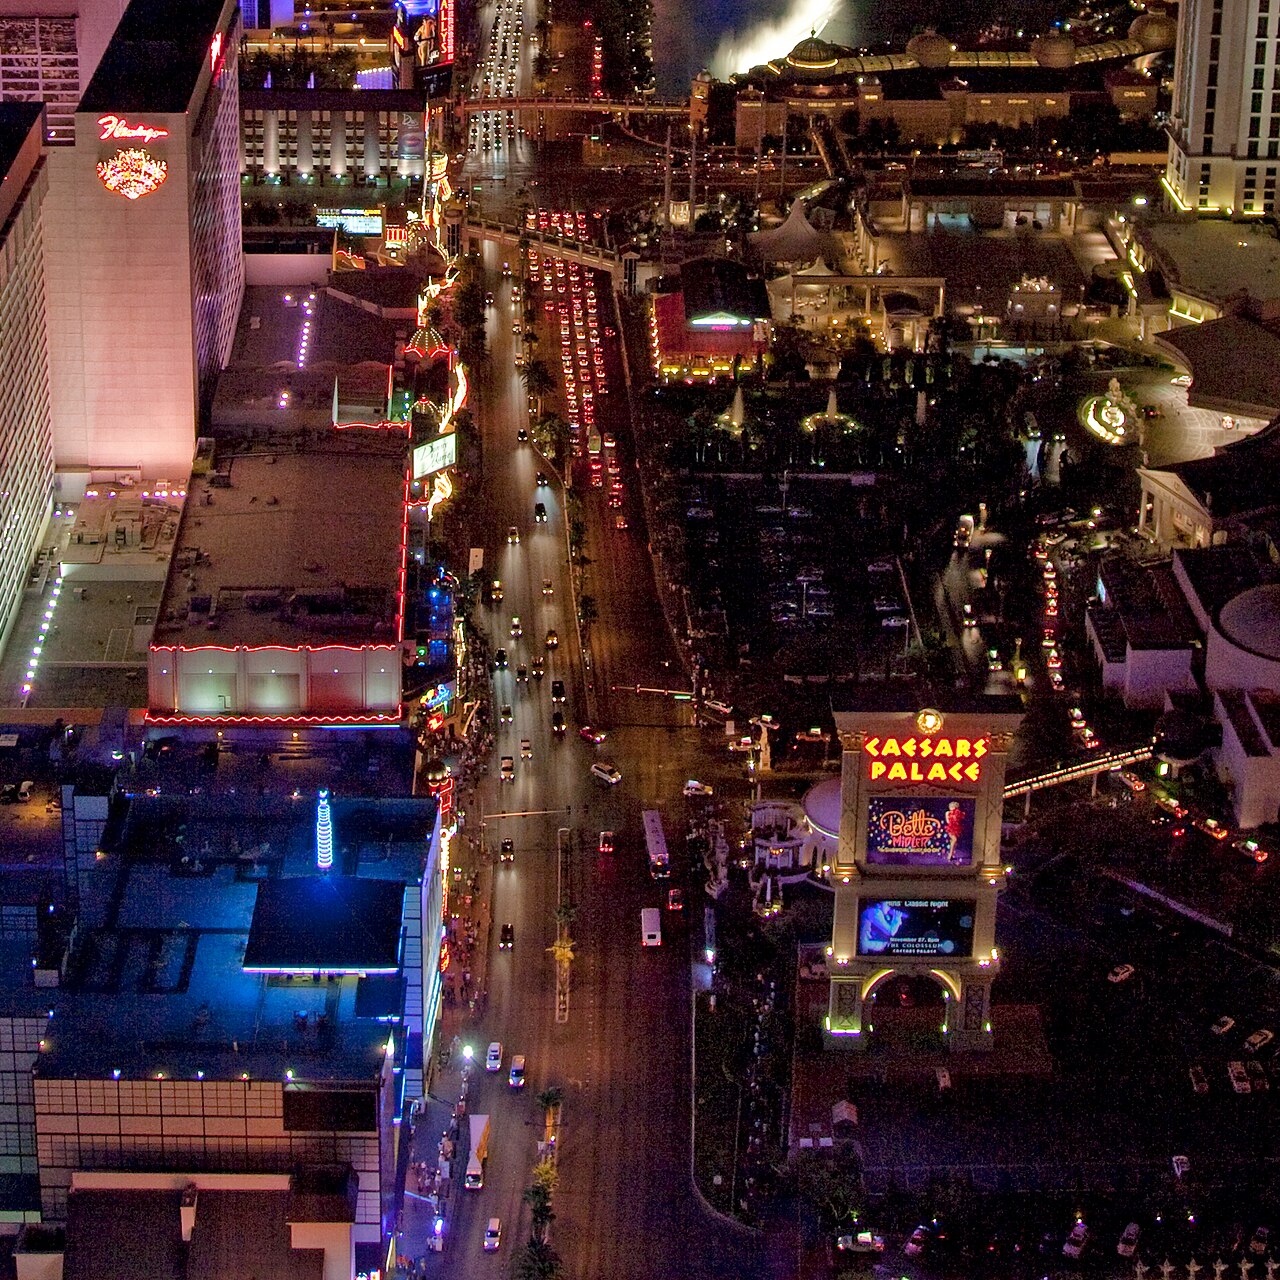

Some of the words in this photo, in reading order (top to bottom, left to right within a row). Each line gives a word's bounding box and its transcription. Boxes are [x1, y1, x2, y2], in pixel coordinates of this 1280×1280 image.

[97, 115, 168, 143] Flamingo
[865, 737, 988, 758] CAESARS
[871, 761, 980, 782] PALACE
[880, 809, 941, 836] Bette
[930, 901, 949, 909] Night
